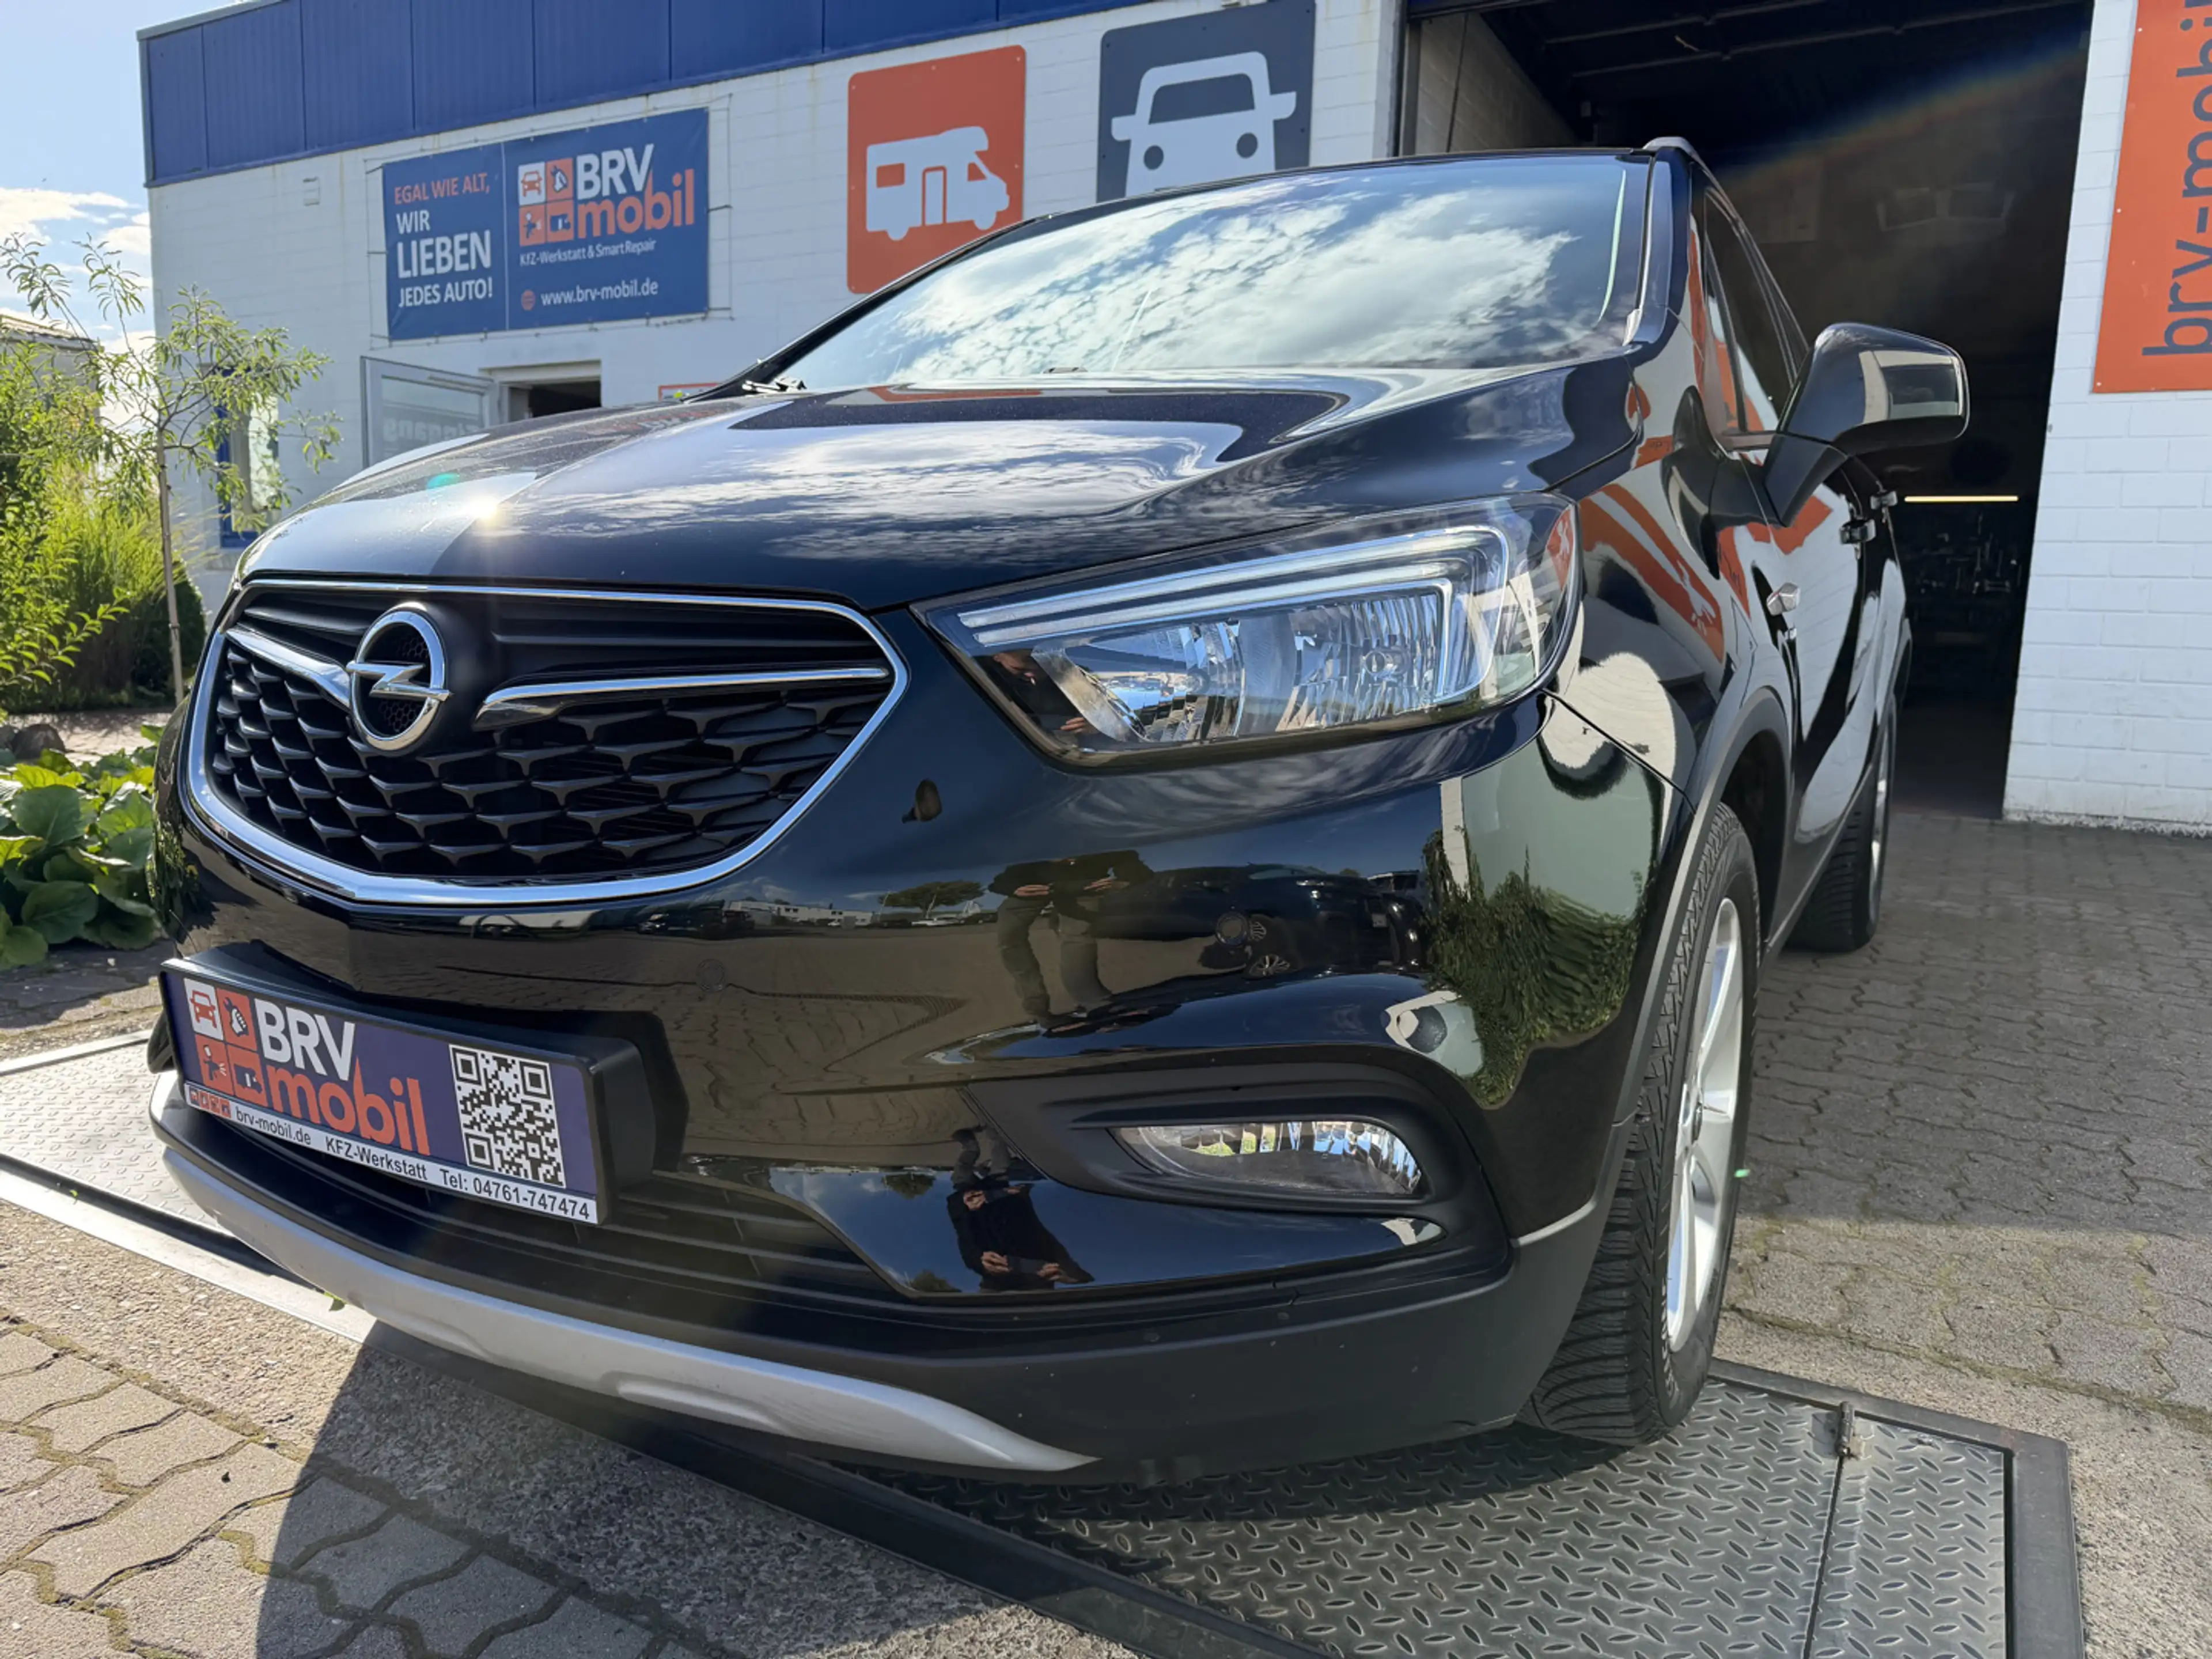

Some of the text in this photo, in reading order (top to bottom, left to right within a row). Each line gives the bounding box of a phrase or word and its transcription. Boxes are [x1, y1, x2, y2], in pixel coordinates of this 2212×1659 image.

[395, 172, 490, 205] EGAL WIE ALT,
[576, 143, 654, 200] BRV
[396, 209, 431, 234] WIR
[577, 168, 695, 239] mobil
[397, 229, 491, 279] LIEBEN
[398, 276, 493, 308] JEDES AUTO!
[540, 278, 659, 306] www.brv-mobil.de
[254, 998, 355, 1081] BRV
[266, 1055, 430, 1156] mobil
[235, 1106, 590, 1220] brv-mobil.de KFZ-Werkstatt Tel: 04761-747474
